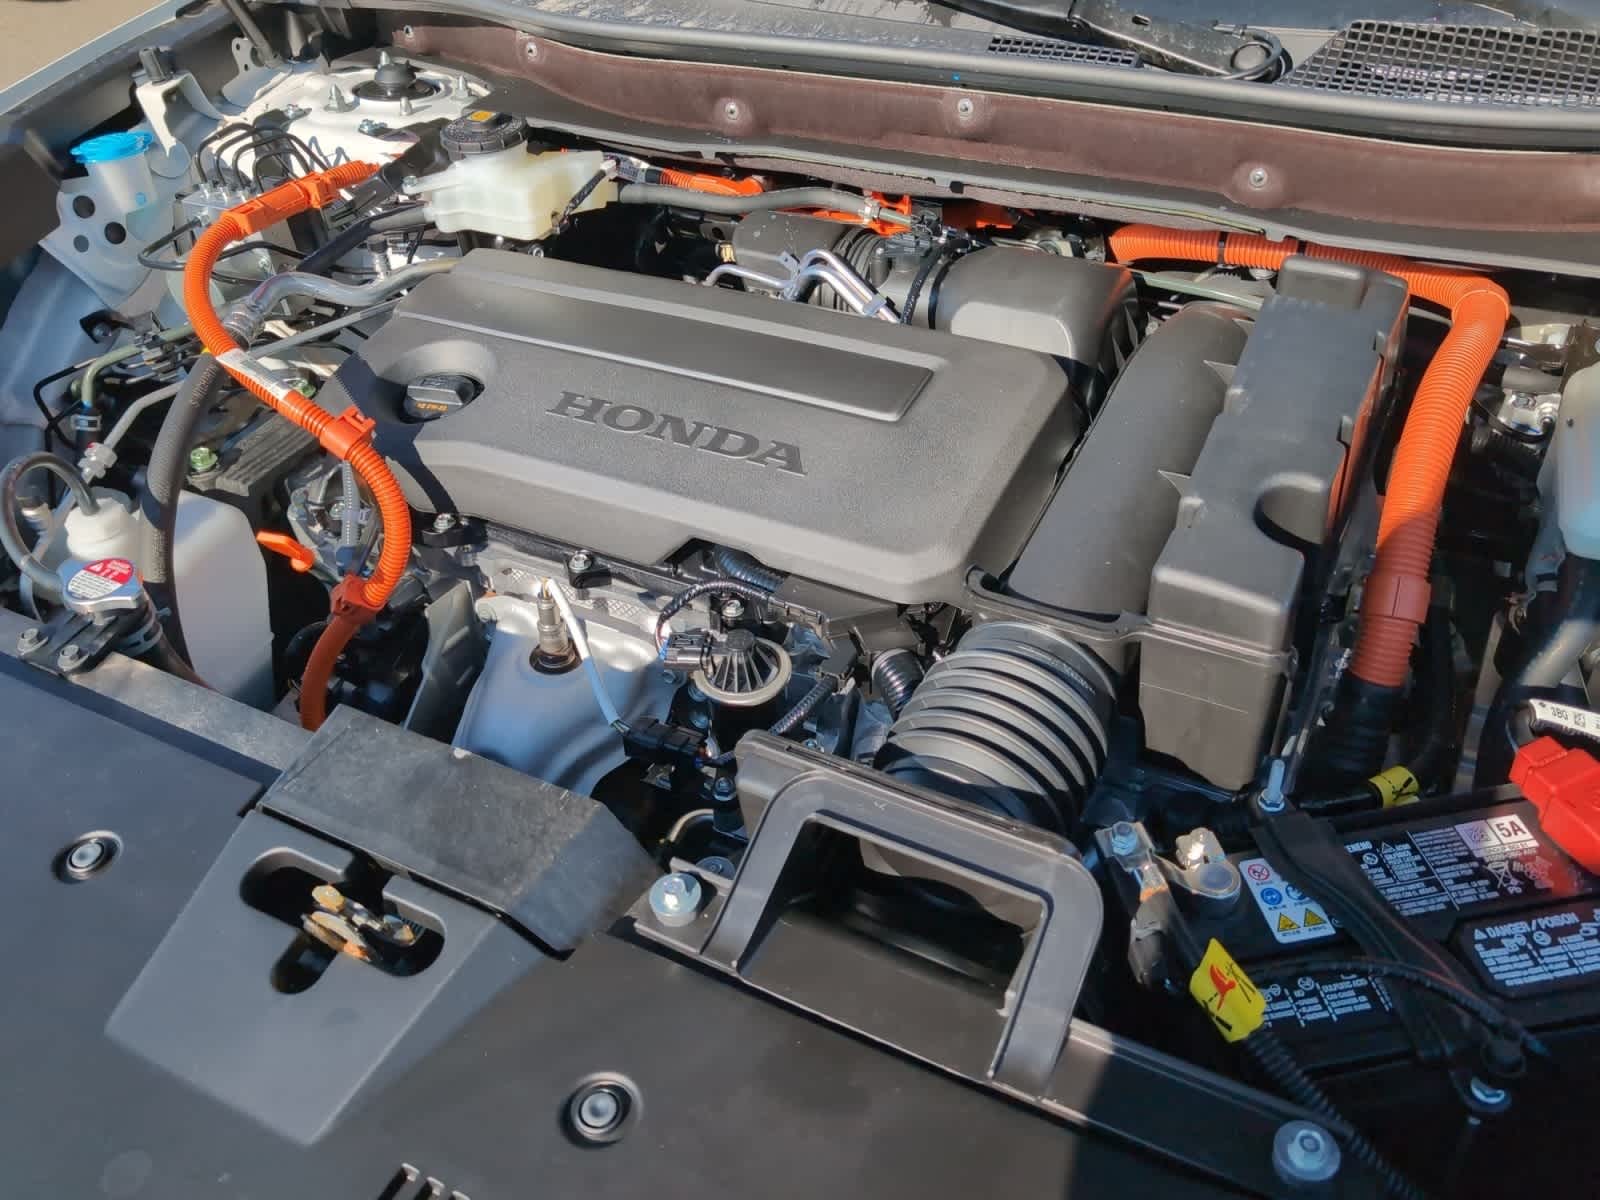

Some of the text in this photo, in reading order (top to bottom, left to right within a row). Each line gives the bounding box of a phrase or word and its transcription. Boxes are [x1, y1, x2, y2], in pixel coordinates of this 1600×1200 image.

[545, 391, 808, 477] HONDA
[1495, 820, 1527, 838] 5A
[1485, 921, 1531, 938] DANGER
[1536, 912, 1580, 929] POISON
